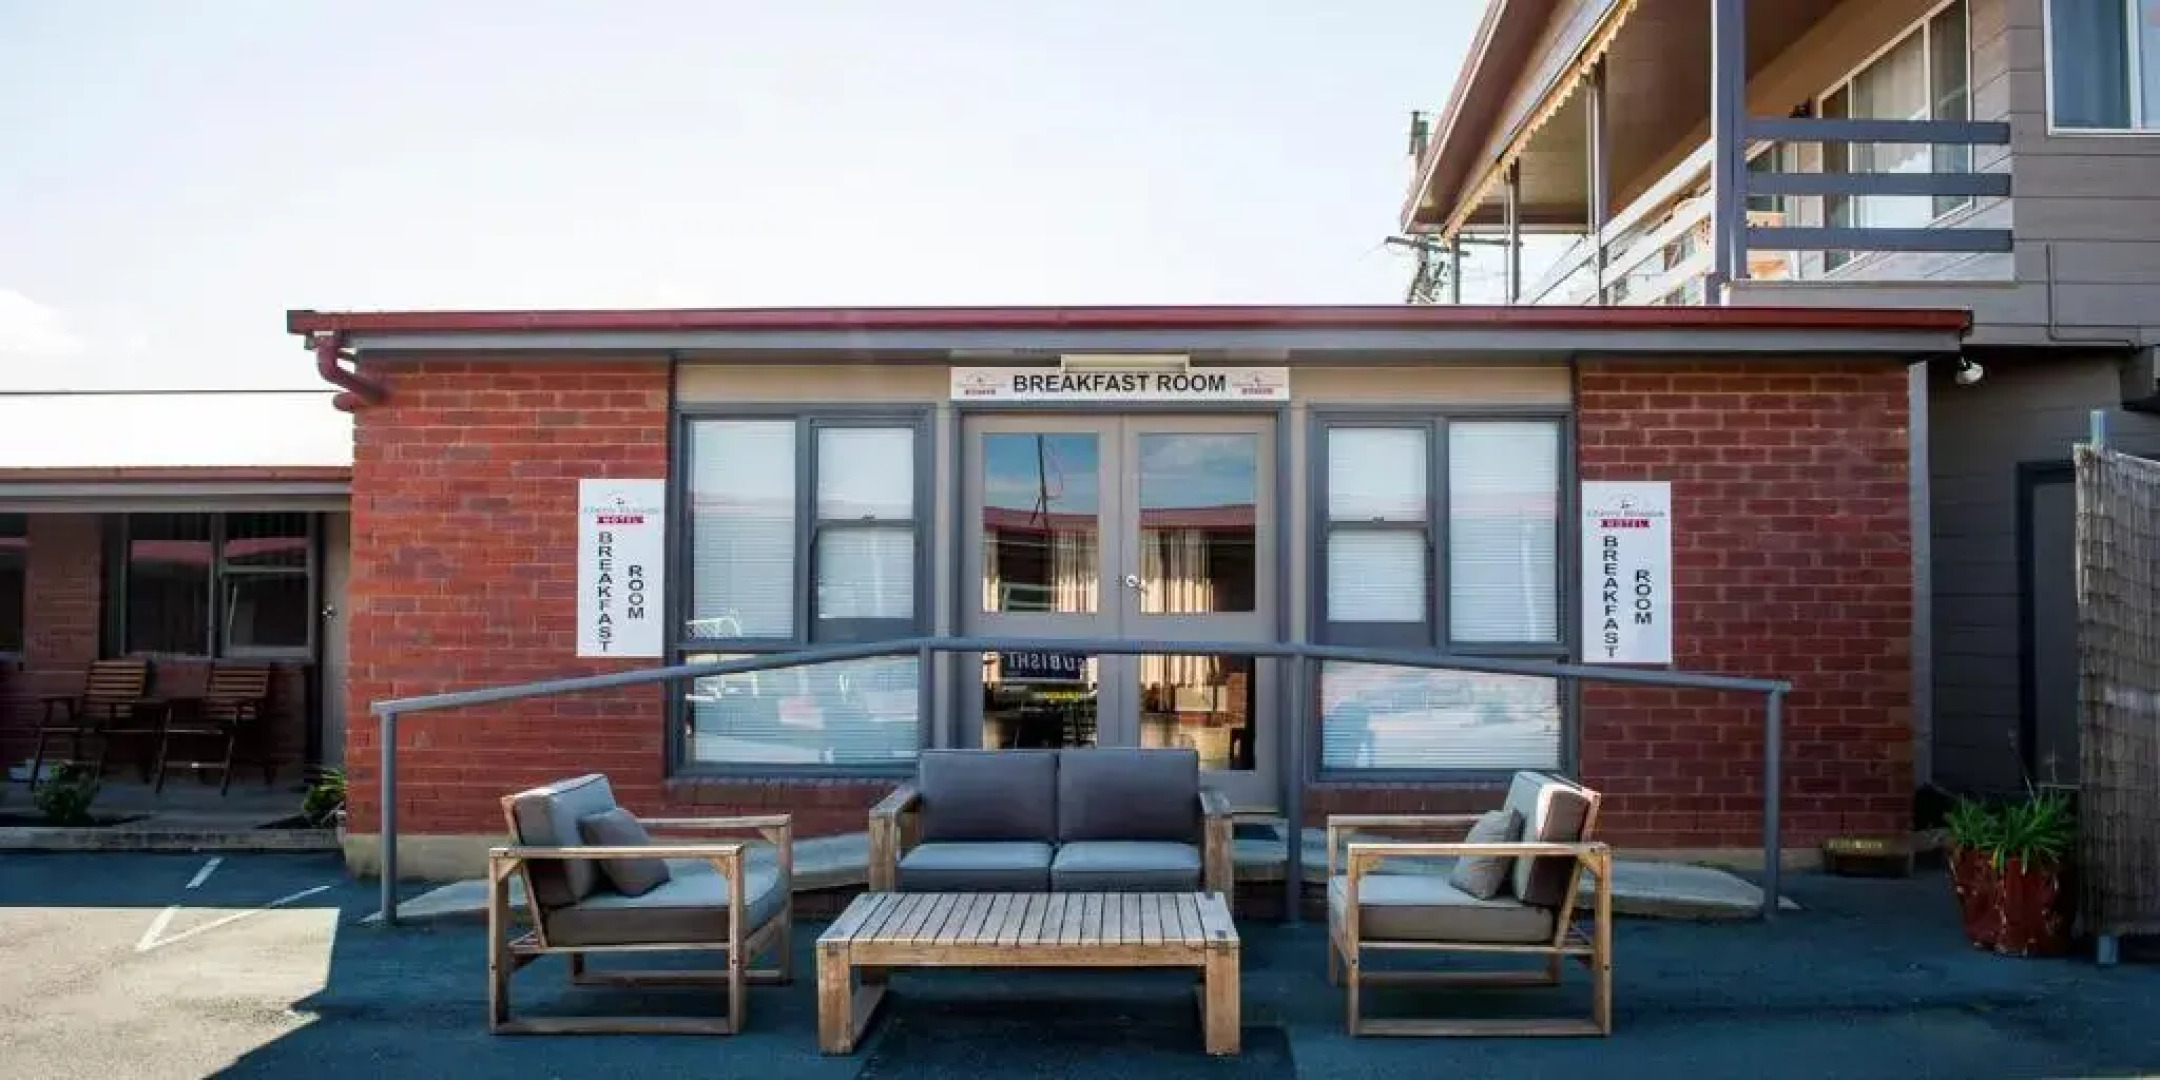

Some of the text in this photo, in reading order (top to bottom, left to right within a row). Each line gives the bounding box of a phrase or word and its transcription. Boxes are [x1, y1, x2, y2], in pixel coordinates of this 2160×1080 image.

[1013, 375, 1150, 392] BREAKFAST
[1157, 375, 1226, 392] ROOM
[598, 531, 612, 652] BREAKFAST
[628, 565, 644, 619] ROOM
[1603, 535, 1618, 658] BREAKFAST
[1635, 569, 1652, 624] ROOM
